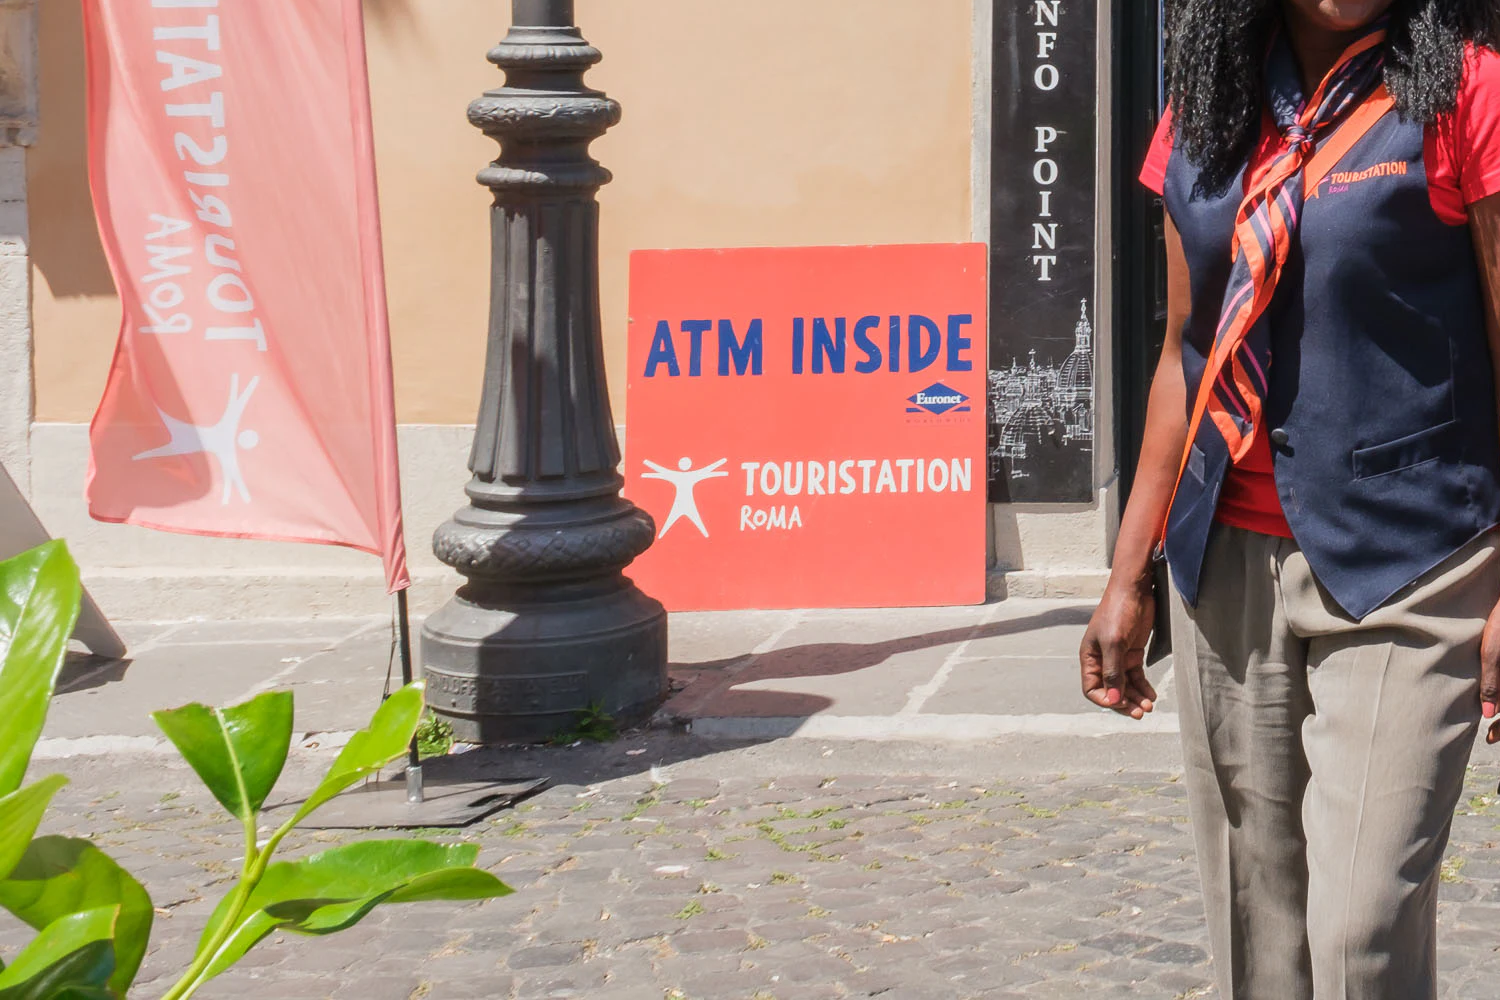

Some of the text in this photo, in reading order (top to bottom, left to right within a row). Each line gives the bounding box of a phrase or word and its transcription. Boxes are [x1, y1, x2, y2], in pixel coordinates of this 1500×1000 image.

[1331, 161, 1407, 185] TOURISTATION
[1032, 127, 1059, 281] POINT
[644, 314, 972, 377] ATM INSIDE
[915, 391, 963, 405] Euronet
[741, 458, 972, 496] TOURISTATION
